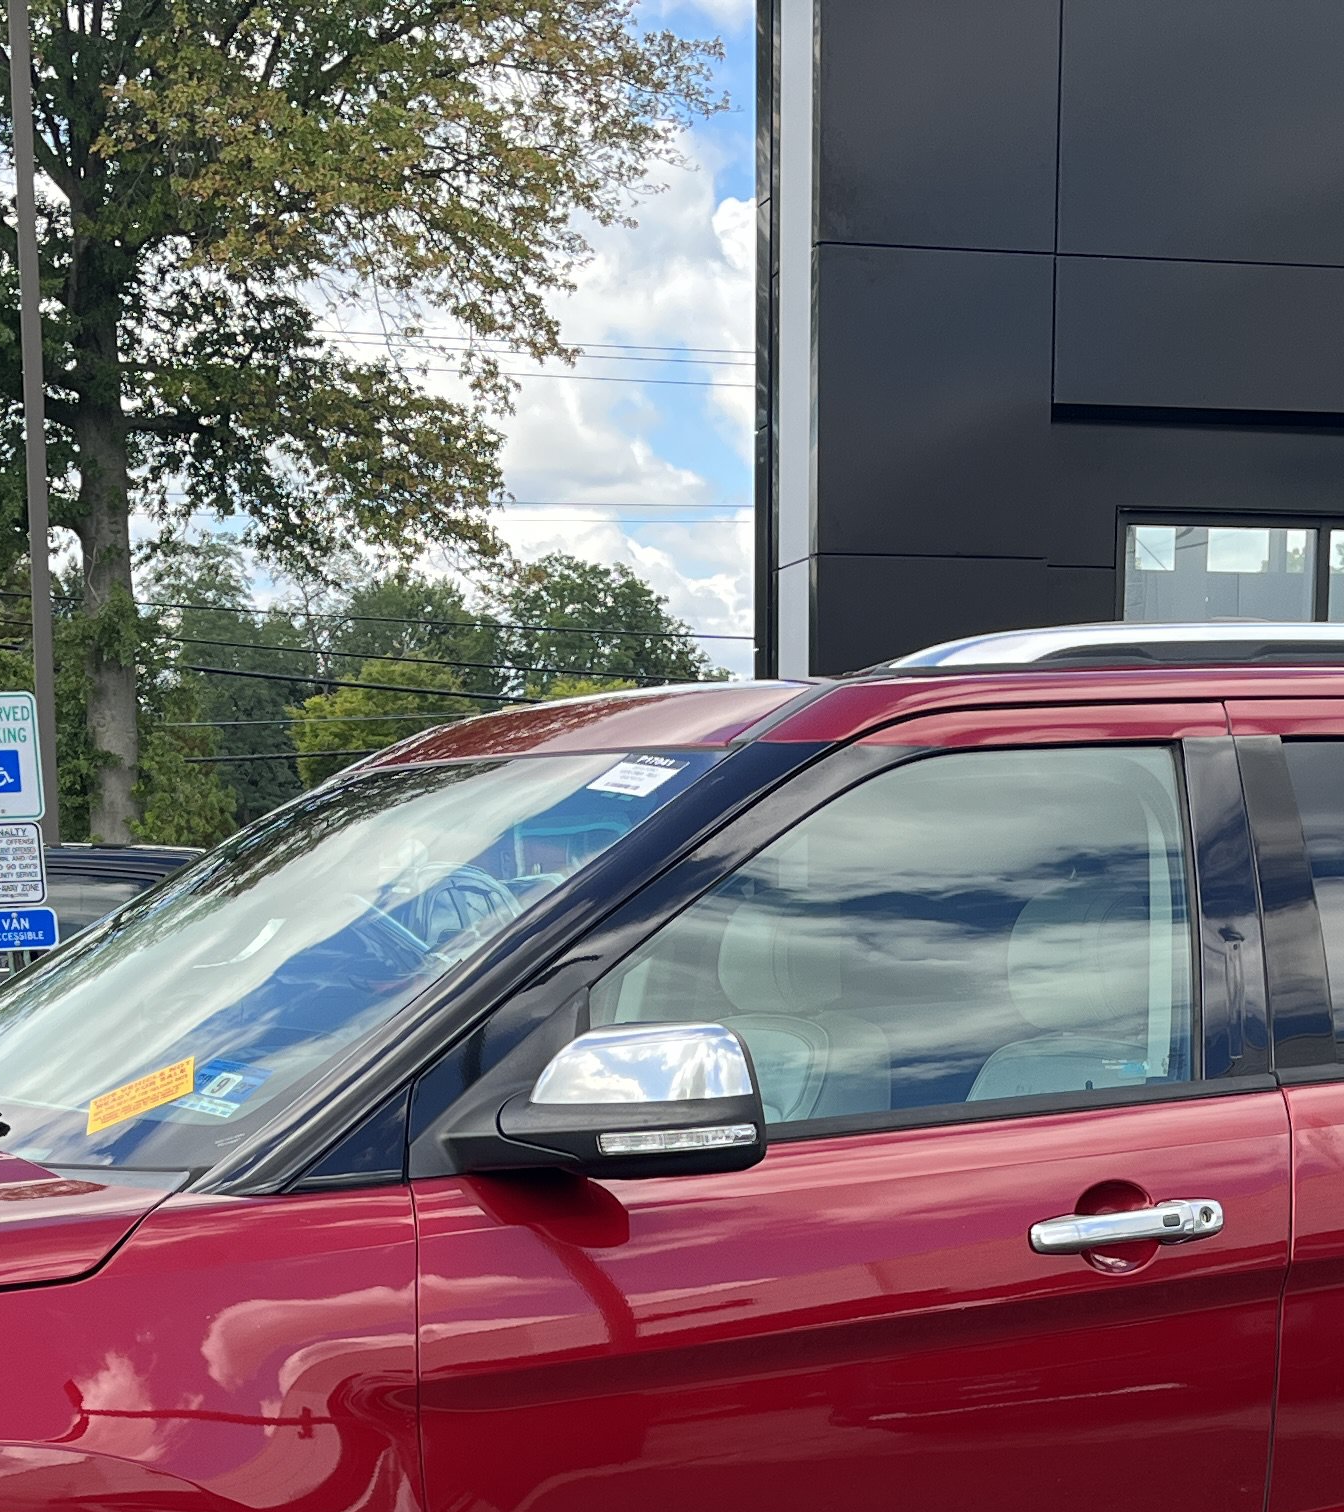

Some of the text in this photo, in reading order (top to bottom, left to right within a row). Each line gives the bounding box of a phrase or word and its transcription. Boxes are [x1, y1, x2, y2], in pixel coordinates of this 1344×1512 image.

[21, 883, 40, 892] ZONE
[1, 918, 30, 930] VAN
[210, 1077, 231, 1094] 9
